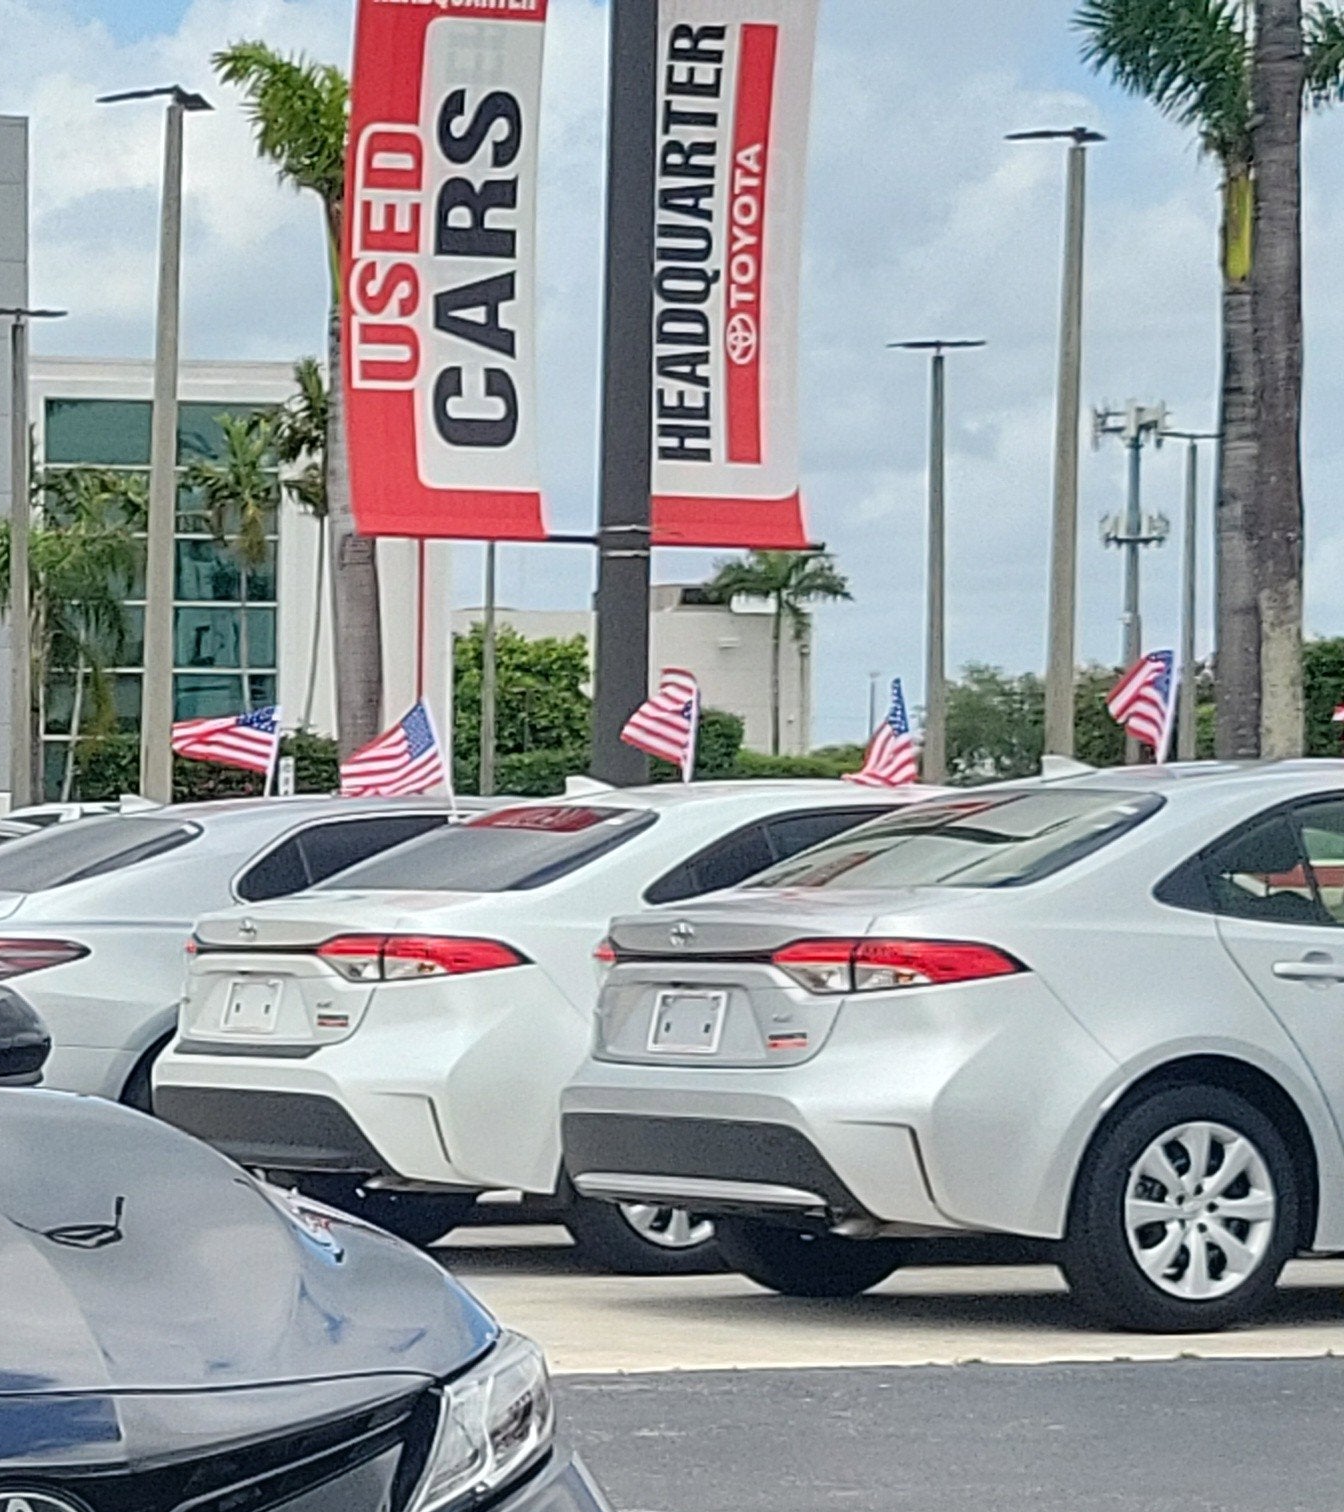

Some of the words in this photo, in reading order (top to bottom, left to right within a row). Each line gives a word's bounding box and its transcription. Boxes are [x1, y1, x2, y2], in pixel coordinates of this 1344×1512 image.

[349, 121, 426, 391] USED
[433, 87, 523, 448] CARS
[654, 22, 729, 463] HEADQUARTER
[729, 143, 763, 308] TOYOTA
